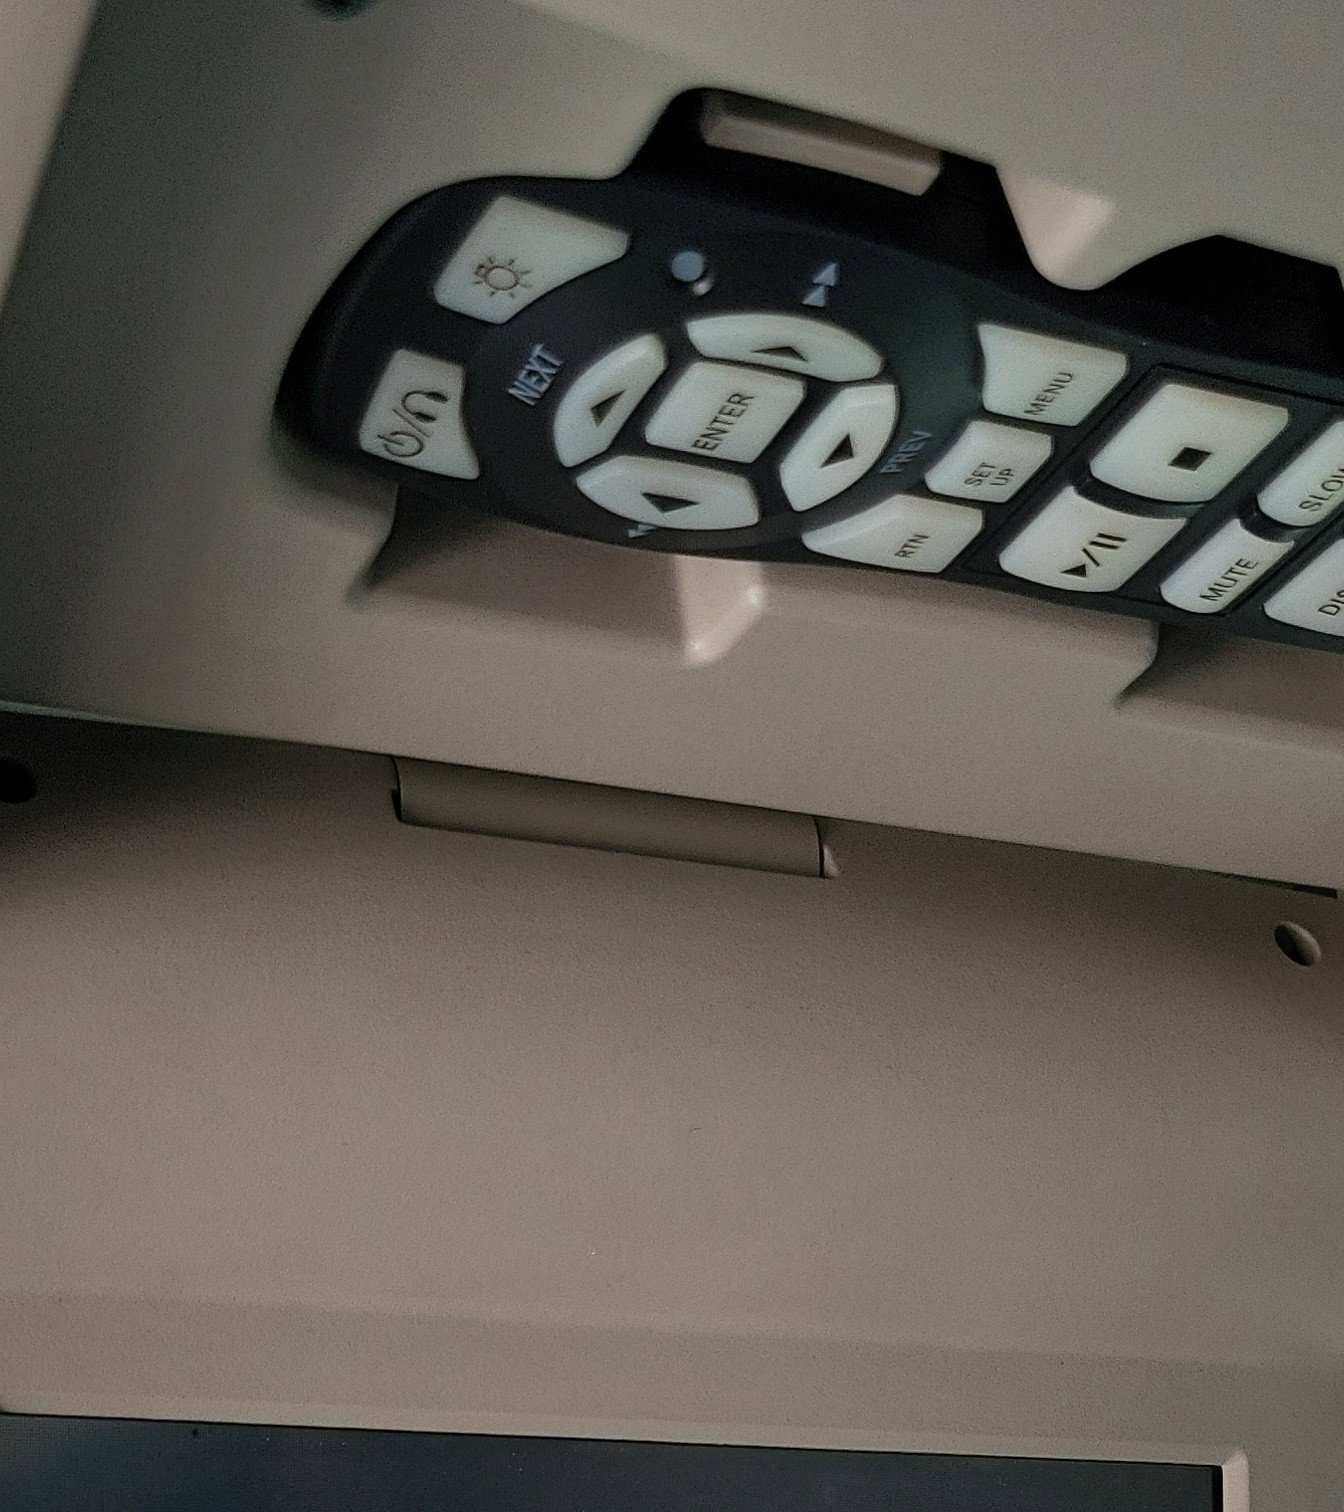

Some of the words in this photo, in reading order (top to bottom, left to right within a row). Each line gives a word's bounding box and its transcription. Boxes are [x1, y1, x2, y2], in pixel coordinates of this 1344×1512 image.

[508, 343, 562, 405] NEXT
[1023, 372, 1073, 415] MENU
[691, 393, 755, 451] ENTER
[880, 428, 933, 474] PREV
[964, 462, 996, 487] SET
[990, 467, 1014, 487] UP
[894, 534, 930, 559] RTN
[1199, 558, 1259, 602] MUTE
